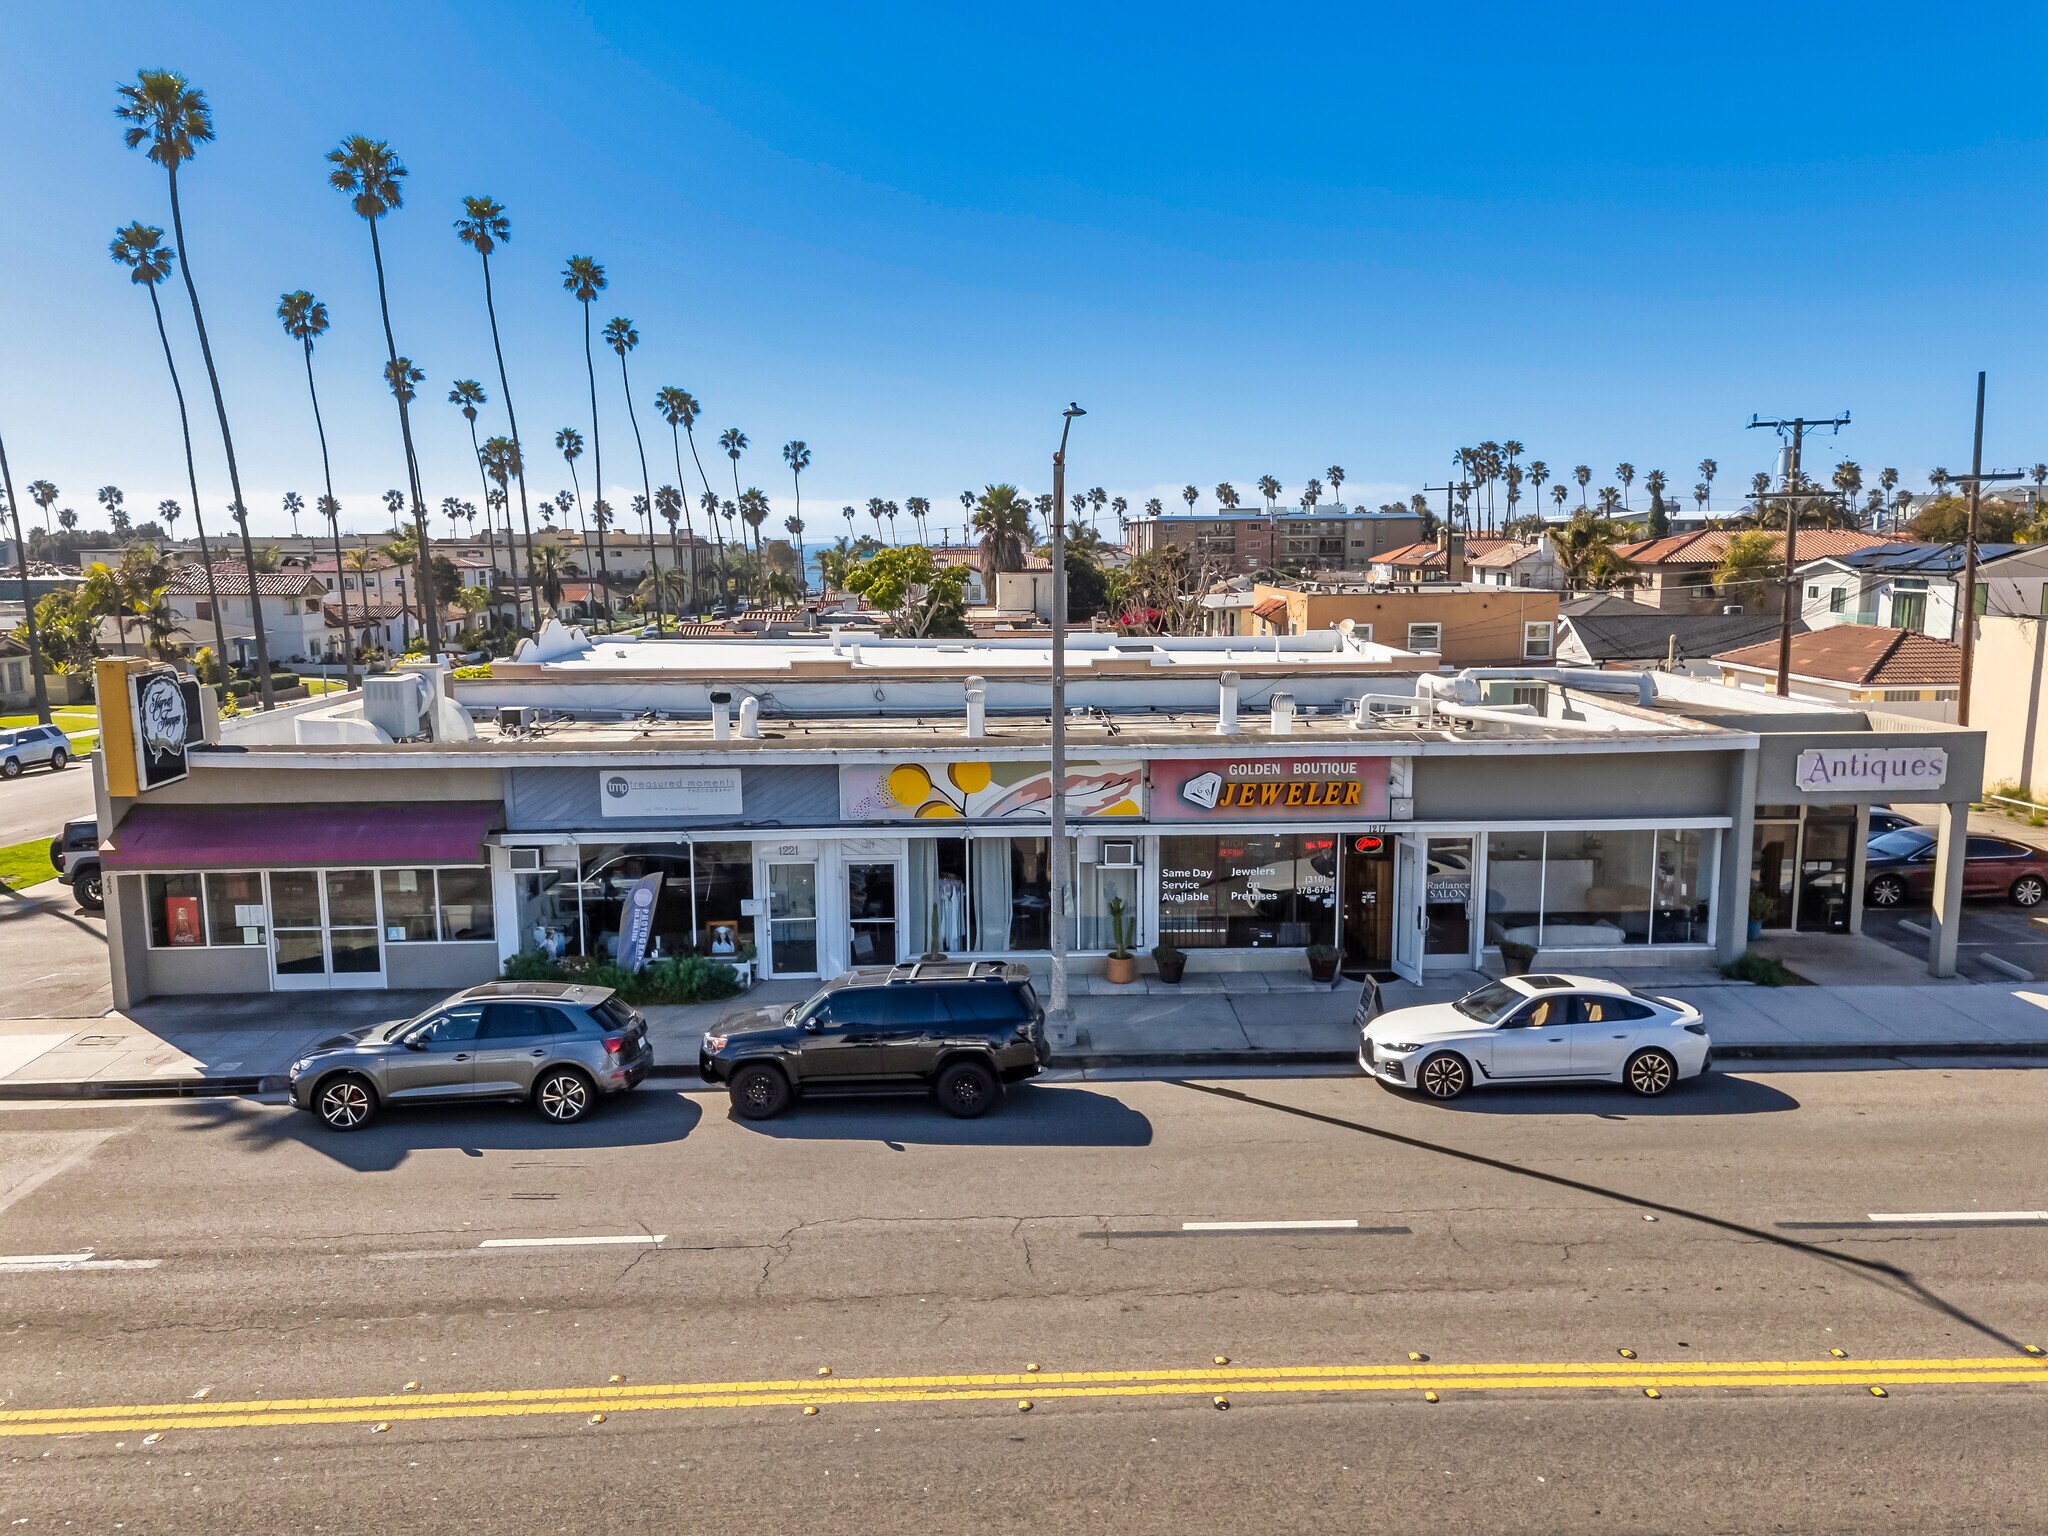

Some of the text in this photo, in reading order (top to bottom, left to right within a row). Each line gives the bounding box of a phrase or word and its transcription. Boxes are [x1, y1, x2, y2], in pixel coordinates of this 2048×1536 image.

[1228, 762, 1358, 776] GOLDEN BOUTIQUE
[1803, 753, 1943, 784] Antiques
[608, 781, 628, 795] tmp
[630, 778, 735, 788] treasured moments
[1219, 781, 1362, 807] JEWELER
[1369, 825, 1387, 833] 1217
[778, 845, 799, 856] 1221
[1162, 869, 1213, 879] Same Day
[1231, 867, 1276, 877] Jewelers
[1305, 875, 1326, 884] (310)
[1162, 881, 1200, 890] Service
[1246, 881, 1260, 889] on
[1296, 885, 1335, 895] 378-6794
[1427, 881, 1471, 890] Radiance
[1162, 891, 1209, 901] Available
[1231, 891, 1278, 901] Premises
[1429, 889, 1466, 899] SALON
